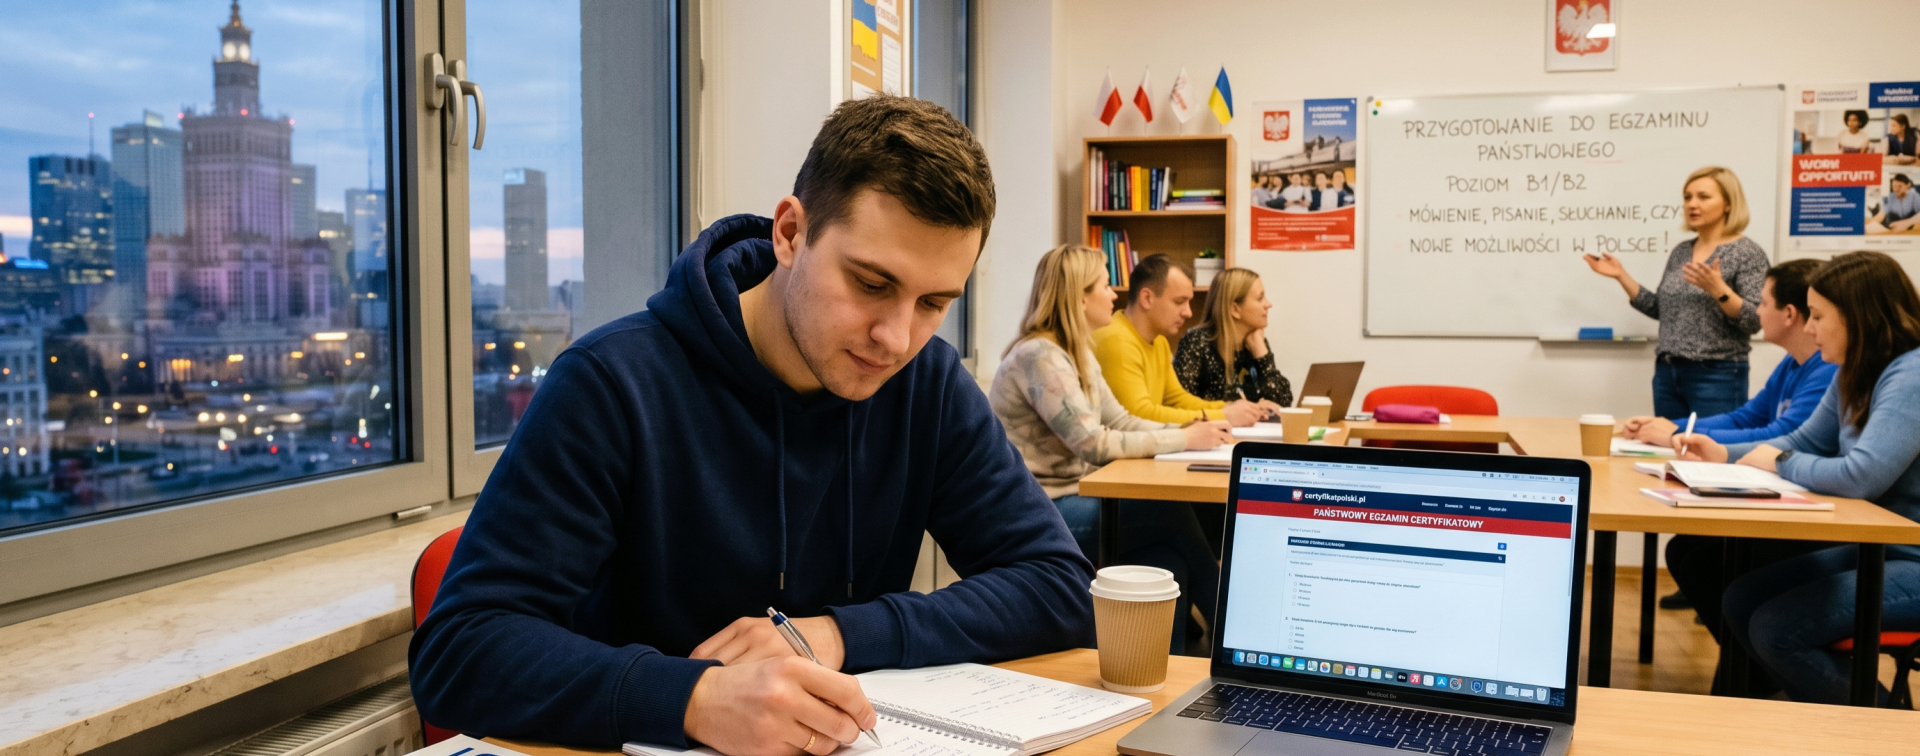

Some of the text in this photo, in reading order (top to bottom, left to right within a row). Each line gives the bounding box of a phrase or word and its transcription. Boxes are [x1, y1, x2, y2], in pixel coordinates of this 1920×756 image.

[1402, 111, 1709, 139] PRZYGOTOWANIE DO EGZAMINU
[1477, 140, 1616, 162] PAŃSTWOWEGO
[1799, 159, 1840, 170] WORK
[1445, 171, 1587, 197] POZIOM B1/B2
[1409, 203, 1685, 225] MÓWIENIE, PISANIE, SŁUCHANIE, CZY
[1410, 237, 1453, 253] NOWE
[1464, 232, 1560, 253] MOŻLIWOŚCI
[1572, 237, 1586, 253] W
[1304, 492, 1366, 503] certyfikatpolski.pl
[1313, 507, 1484, 530] PAŃSTWOWY EGZAMIN CERTYFIKATOWY
